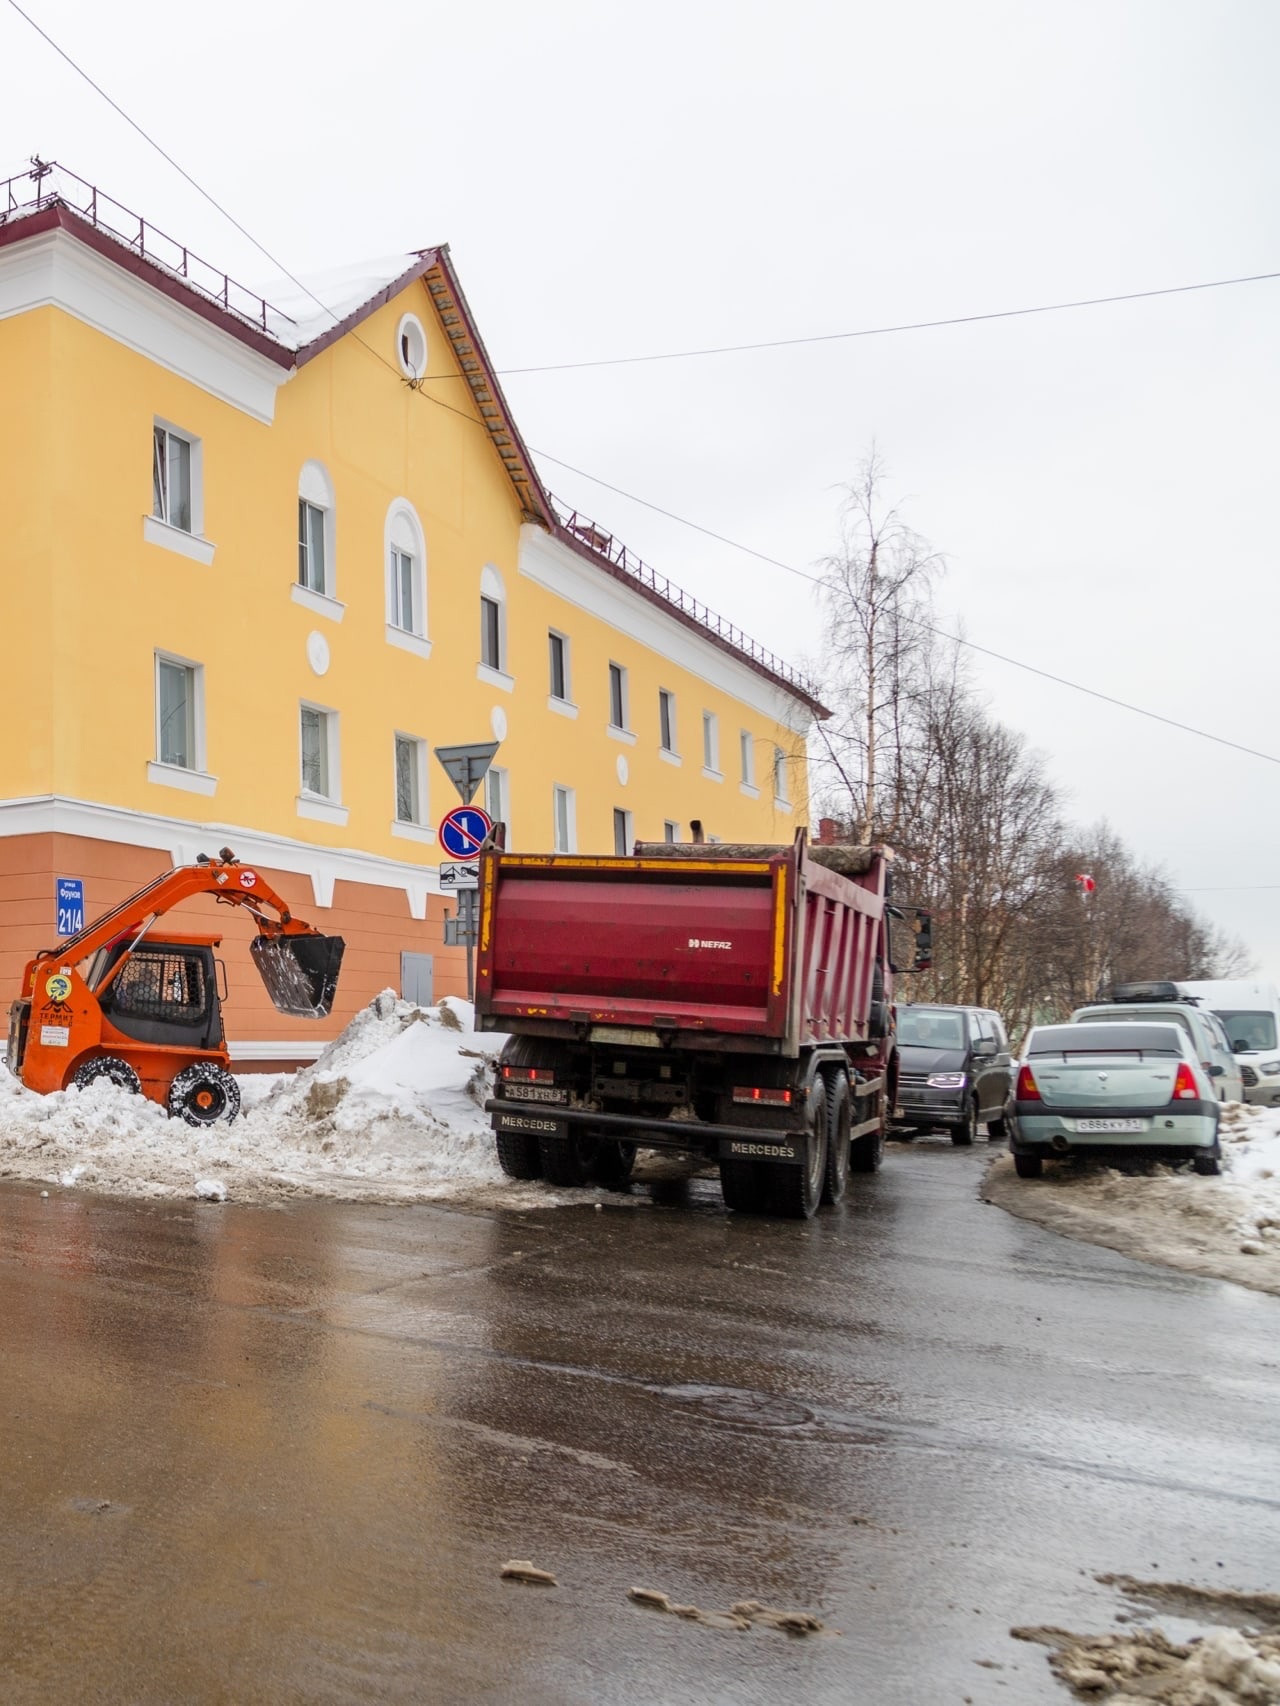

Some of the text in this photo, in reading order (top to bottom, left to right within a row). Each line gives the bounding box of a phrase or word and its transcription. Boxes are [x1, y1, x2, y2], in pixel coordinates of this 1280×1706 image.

[60, 888, 81, 900] Фрунзе
[59, 908, 82, 933] 21/4
[701, 940, 732, 950] NEFAZ
[40, 1012, 73, 1021] ТЕРМИТ
[501, 1116, 557, 1131] MERCEDES
[731, 1142, 795, 1157] MERCEDES
